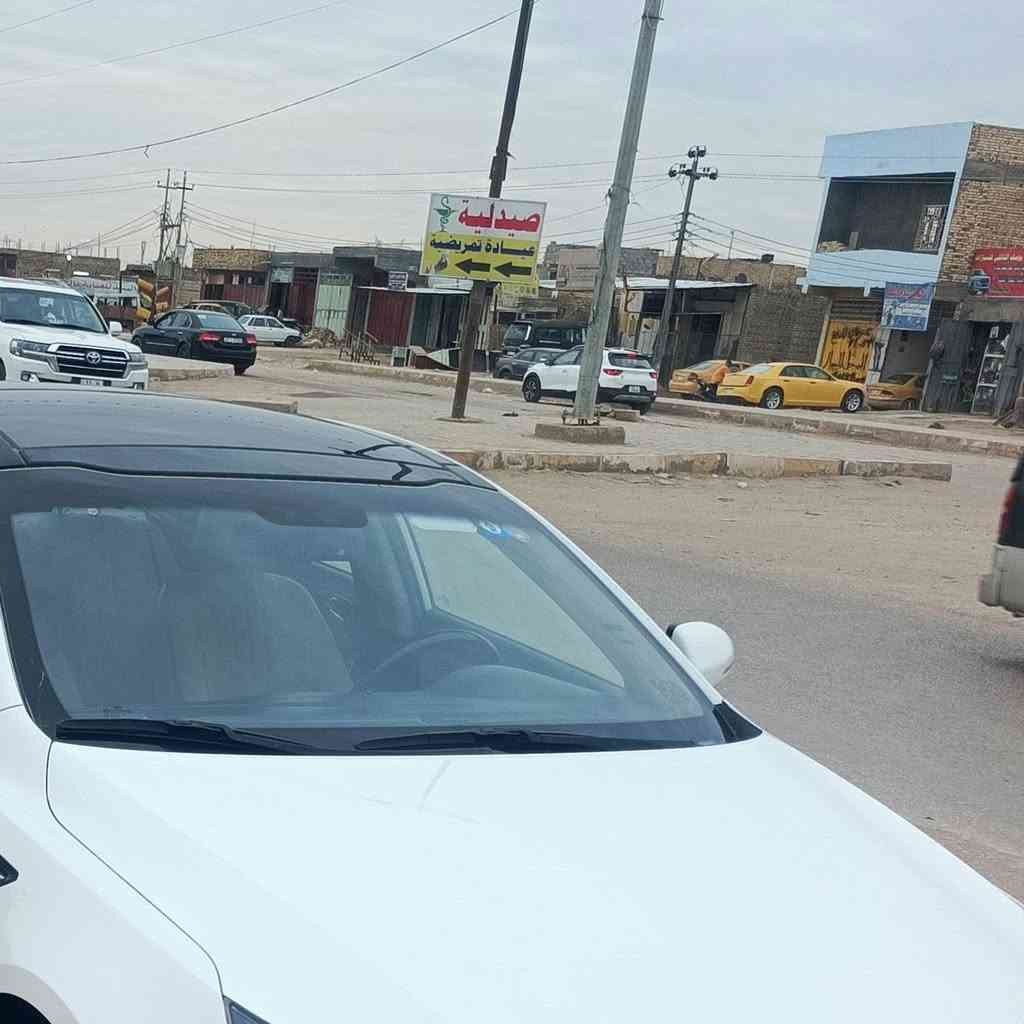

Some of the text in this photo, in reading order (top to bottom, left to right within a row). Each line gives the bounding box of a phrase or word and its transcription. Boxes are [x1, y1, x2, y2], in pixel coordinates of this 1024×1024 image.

[458, 200, 541, 235] صيدلية
[430, 233, 536, 260] عيادة تمريضية
